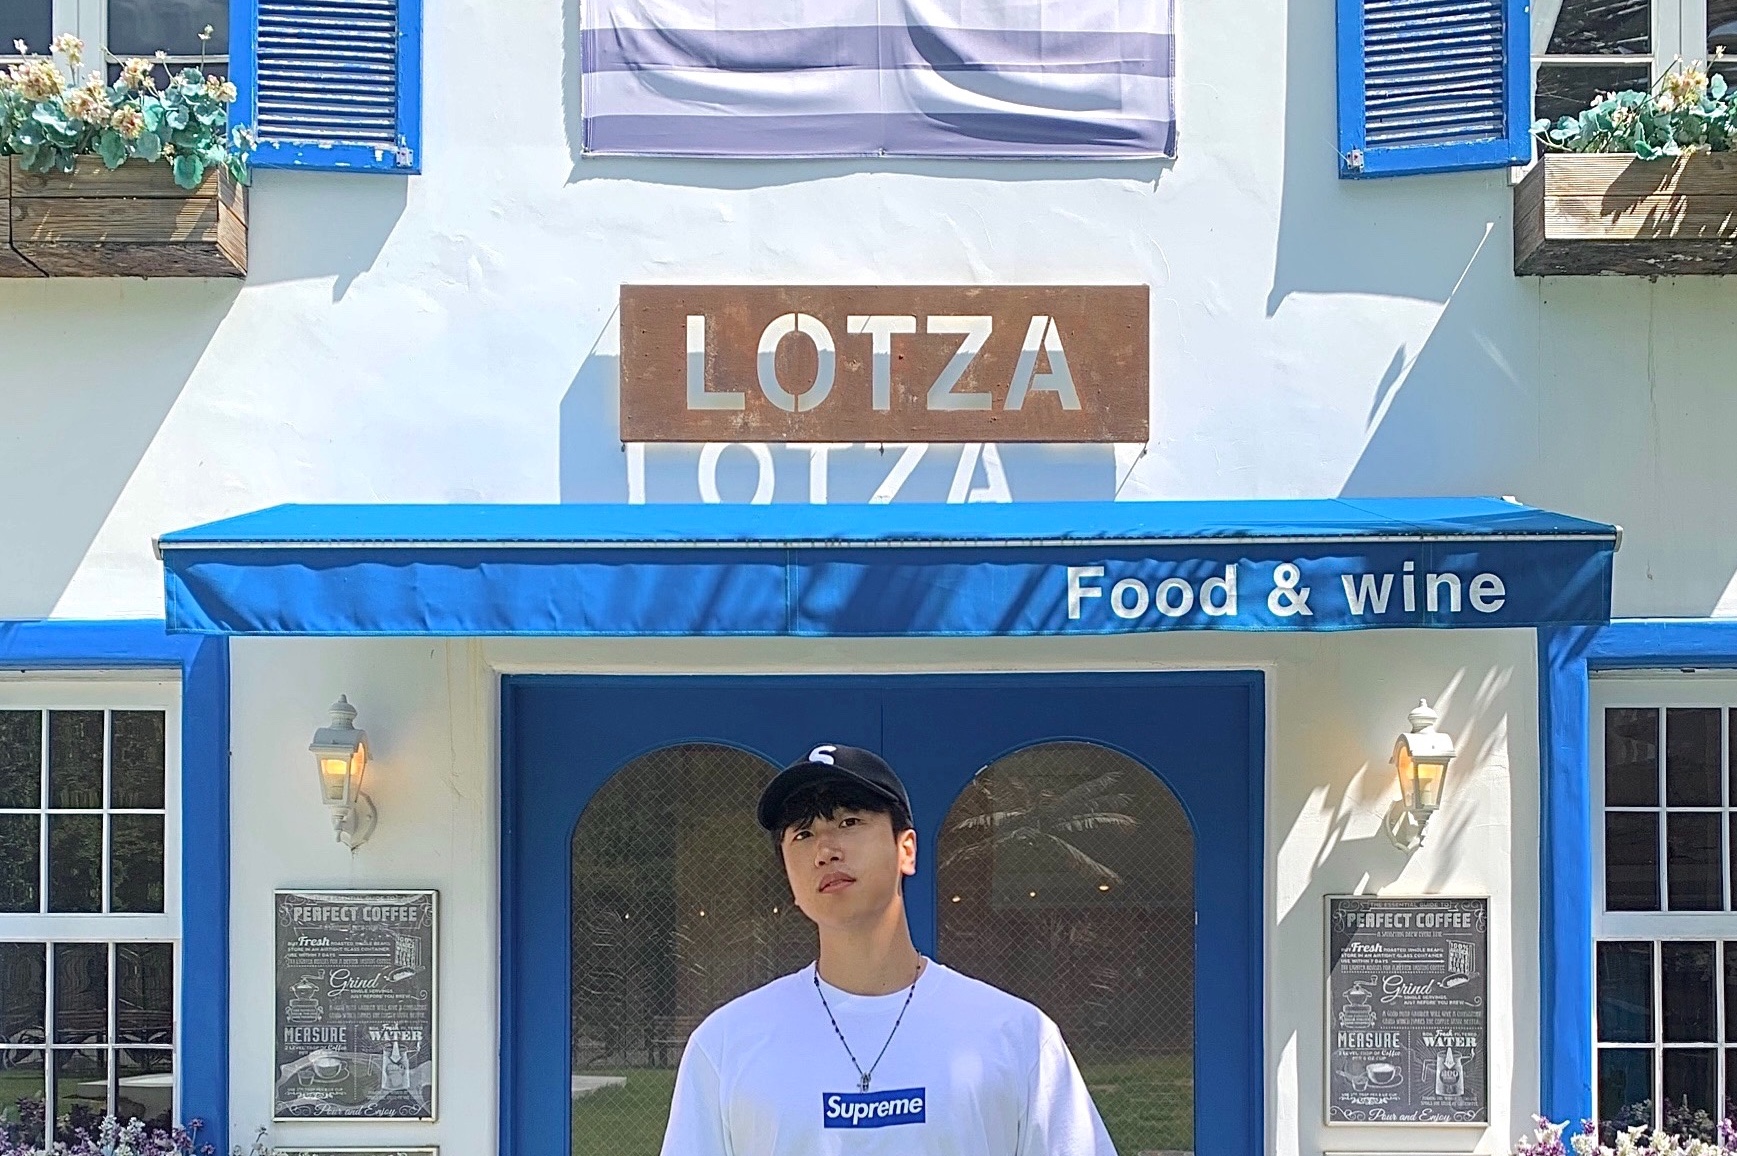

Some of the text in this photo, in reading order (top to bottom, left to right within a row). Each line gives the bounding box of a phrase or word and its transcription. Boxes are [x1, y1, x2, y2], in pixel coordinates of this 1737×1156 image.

[686, 313, 1082, 412] LOTZA
[1067, 561, 1506, 619] Food & wine
[294, 906, 417, 921] PERFECT COFFEE
[1347, 913, 1471, 928] PERFECT COFFEE
[298, 936, 330, 946] Fresh
[1351, 942, 1382, 952] Fresh
[328, 969, 381, 996] Grind
[1381, 975, 1434, 1003] Grind
[284, 1027, 346, 1042] MEASURE
[369, 1031, 422, 1041] WATER
[1338, 1032, 1400, 1048] MEASURE
[1422, 1037, 1477, 1047] WATER
[314, 1103, 396, 1117] Pour and Enjoy
[826, 1096, 924, 1125] Supreme
[1368, 1108, 1452, 1122] Pour and Enjoy
